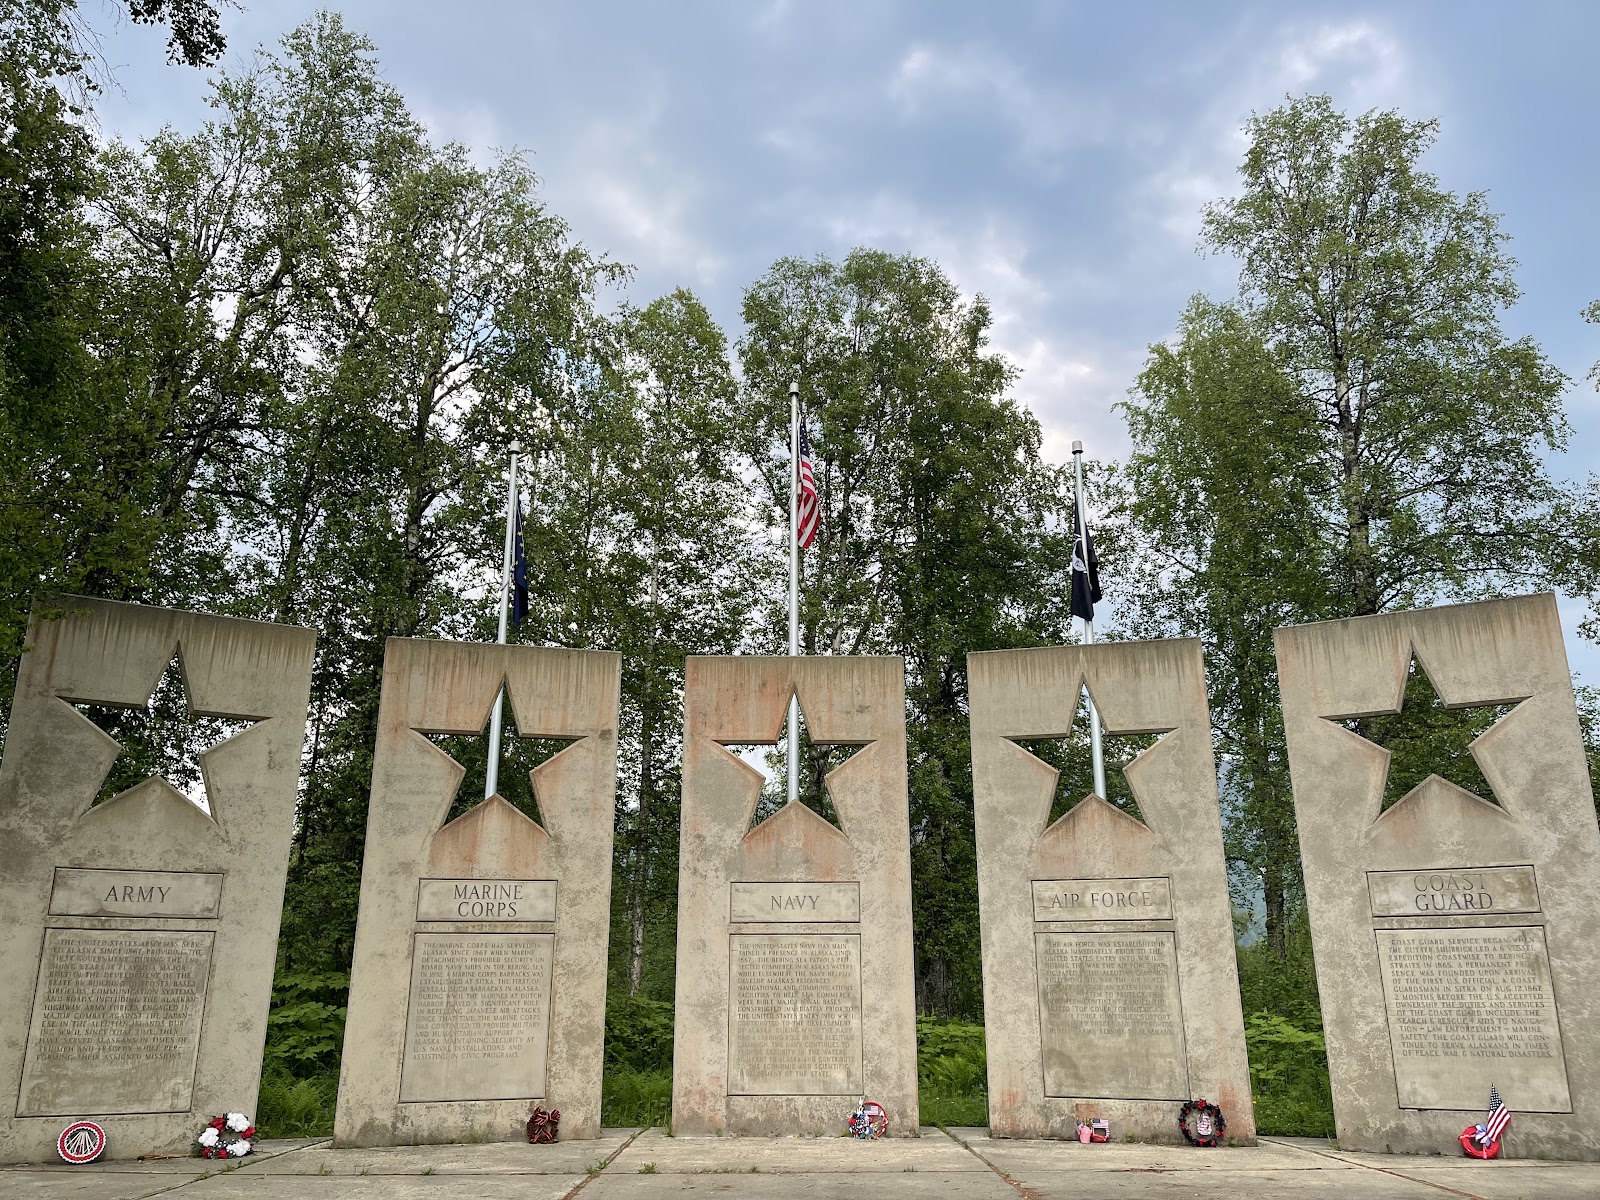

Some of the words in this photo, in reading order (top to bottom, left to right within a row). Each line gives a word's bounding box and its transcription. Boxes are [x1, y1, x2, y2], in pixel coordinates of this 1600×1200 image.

[1414, 874, 1488, 892] COAST
[104, 886, 172, 904] ARMY
[454, 884, 523, 900] MARINE
[1051, 893, 1080, 908] AIR
[1091, 892, 1152, 908] FORCE
[771, 896, 820, 910] NAVY
[1415, 892, 1493, 911] GUARD
[458, 902, 517, 918] CORPS
